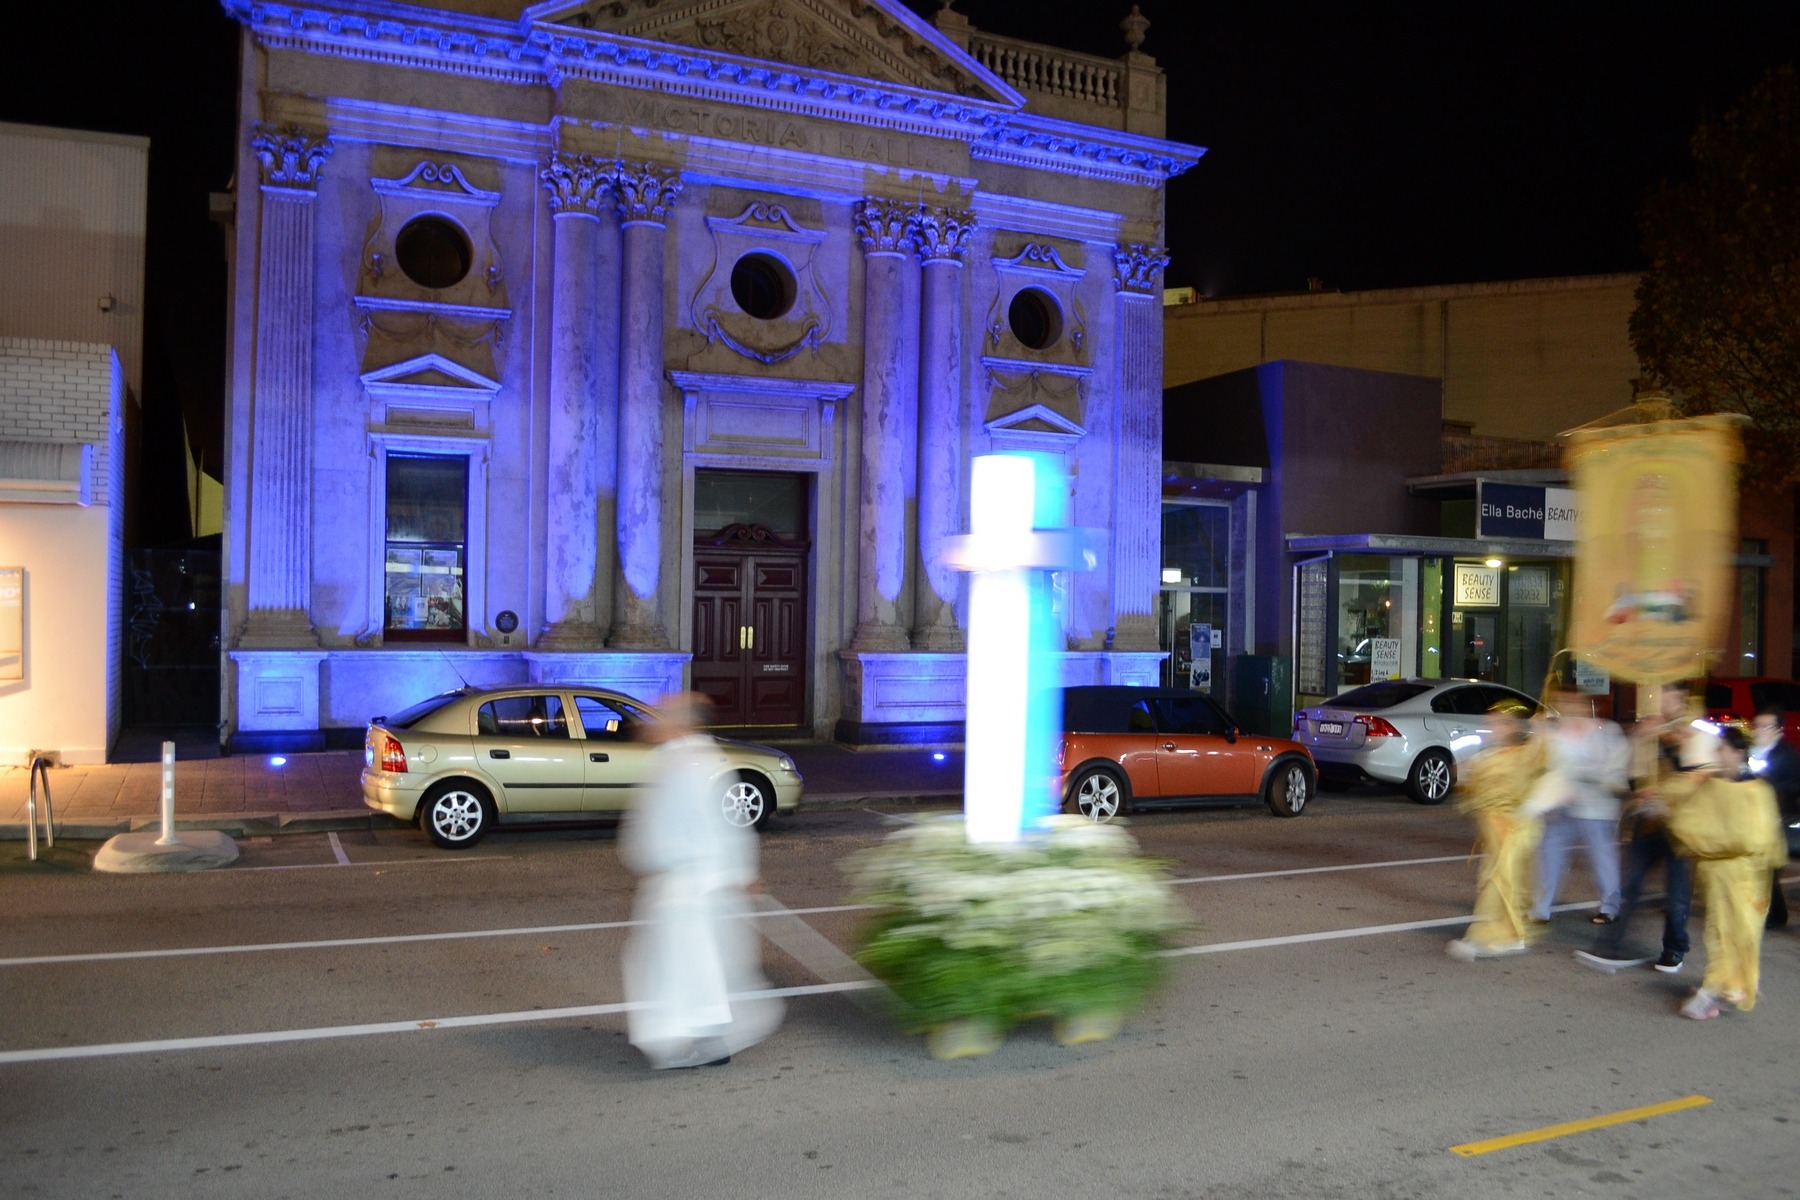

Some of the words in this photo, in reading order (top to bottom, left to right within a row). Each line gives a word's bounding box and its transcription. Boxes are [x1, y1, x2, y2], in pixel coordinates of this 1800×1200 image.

[623, 97, 806, 148] VICTORIA
[1481, 503, 1502, 518] Ella
[1506, 505, 1544, 520] Baché
[1547, 506, 1579, 521] BEAUTY
[1462, 573, 1494, 587] BEAUTY
[1465, 587, 1492, 600] SENSE
[1375, 640, 1398, 650] BEAUTY
[1376, 650, 1397, 659] SENSE
